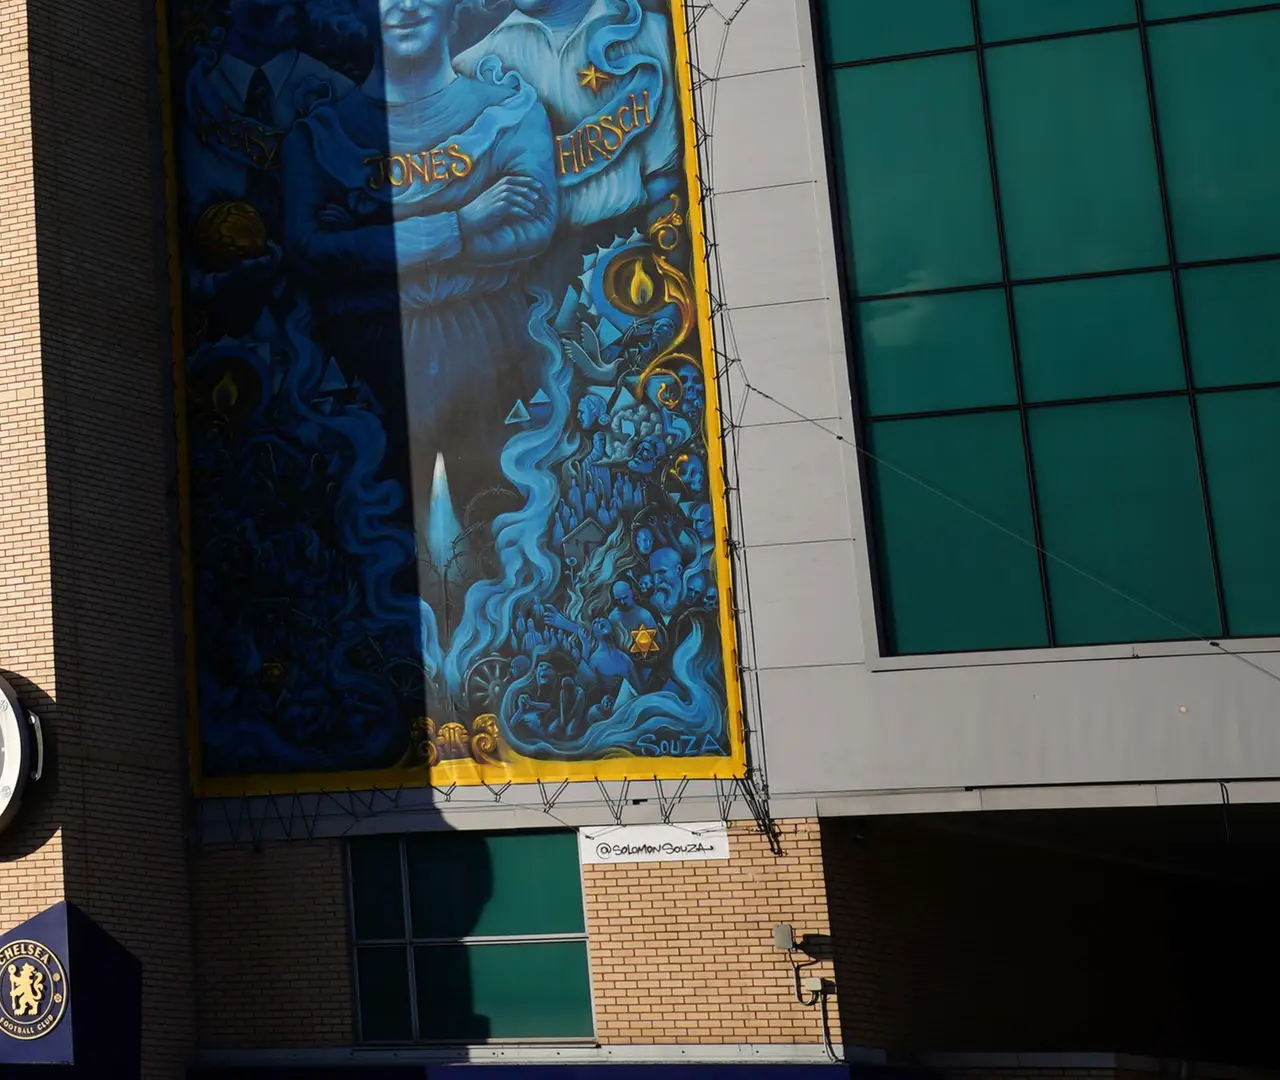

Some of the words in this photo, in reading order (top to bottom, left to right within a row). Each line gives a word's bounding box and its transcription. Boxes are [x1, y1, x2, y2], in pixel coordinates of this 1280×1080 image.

[555, 90, 651, 175] HIRSCH
[364, 143, 473, 190] JONES
[0, 1017, 35, 1034] FOOTBALL
[36, 1014, 54, 1031] CLUB
